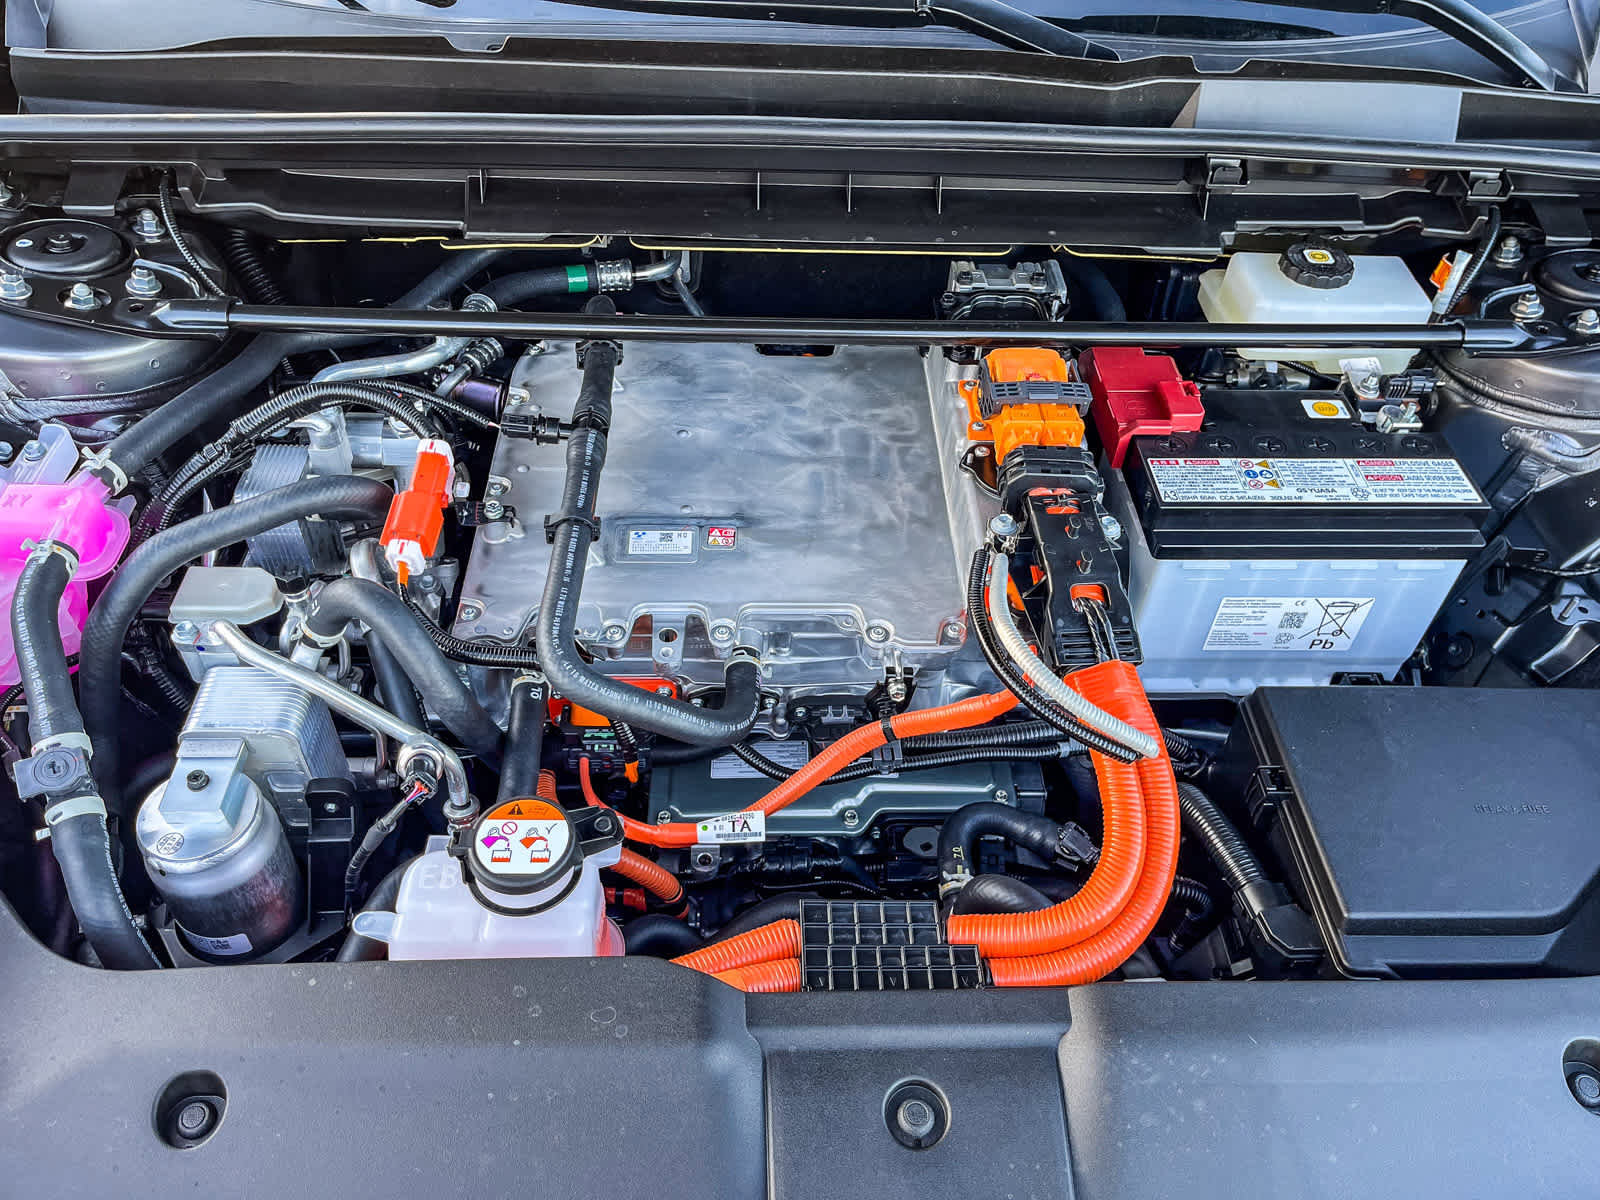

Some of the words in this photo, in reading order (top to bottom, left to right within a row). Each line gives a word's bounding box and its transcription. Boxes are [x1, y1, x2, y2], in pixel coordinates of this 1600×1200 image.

[1163, 490, 1178, 501] A3
[555, 600, 565, 617] WATER
[1308, 639, 1334, 650] Pb
[579, 675, 600, 691] WATER
[662, 704, 680, 717] WATER
[728, 820, 752, 832] TA
